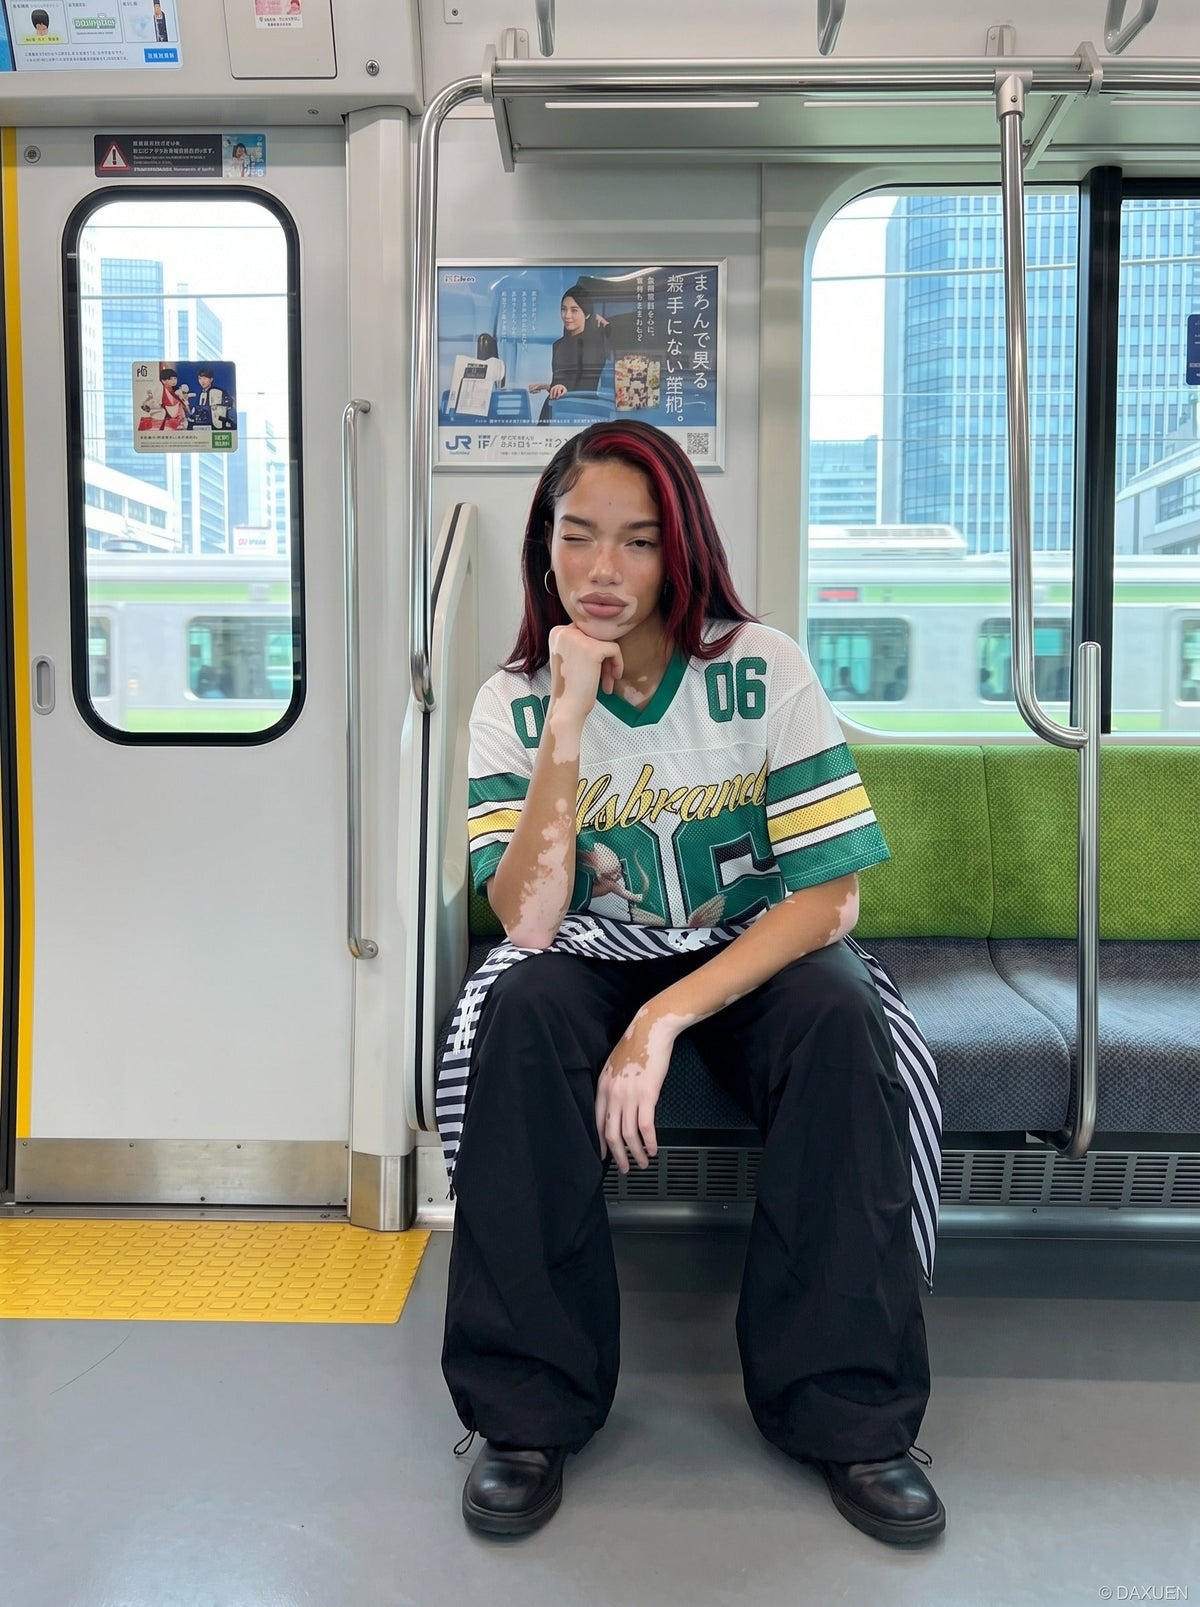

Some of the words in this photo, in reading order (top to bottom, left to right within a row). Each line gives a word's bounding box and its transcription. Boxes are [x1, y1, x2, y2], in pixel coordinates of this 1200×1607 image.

[445, 435, 471, 450] JR
[704, 656, 767, 723] 06
[510, 694, 551, 749] 0
